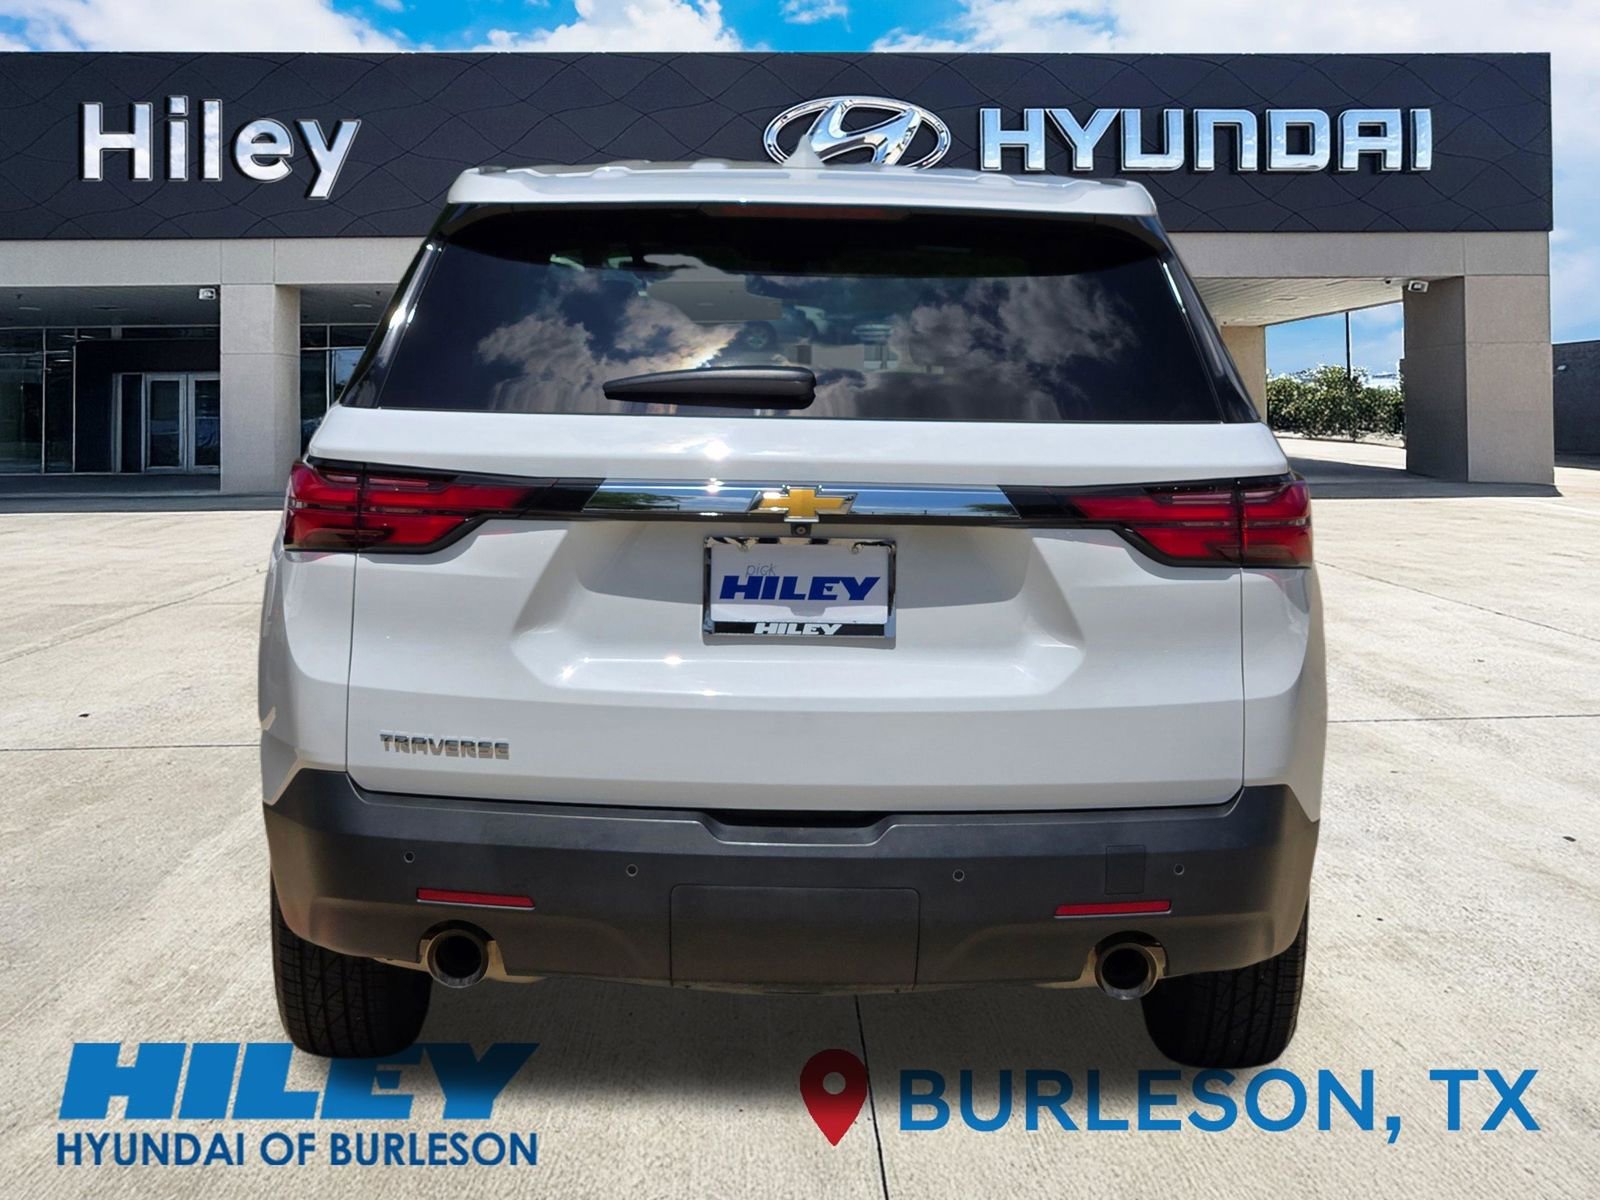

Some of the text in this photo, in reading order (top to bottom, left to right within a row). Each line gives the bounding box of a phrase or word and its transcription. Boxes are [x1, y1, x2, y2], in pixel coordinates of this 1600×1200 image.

[79, 95, 362, 200] Hiley
[979, 107, 1434, 172] HYUNDAI
[719, 575, 881, 601] HILEY
[753, 622, 843, 636] HILEY
[379, 731, 510, 760] TRAVERSE
